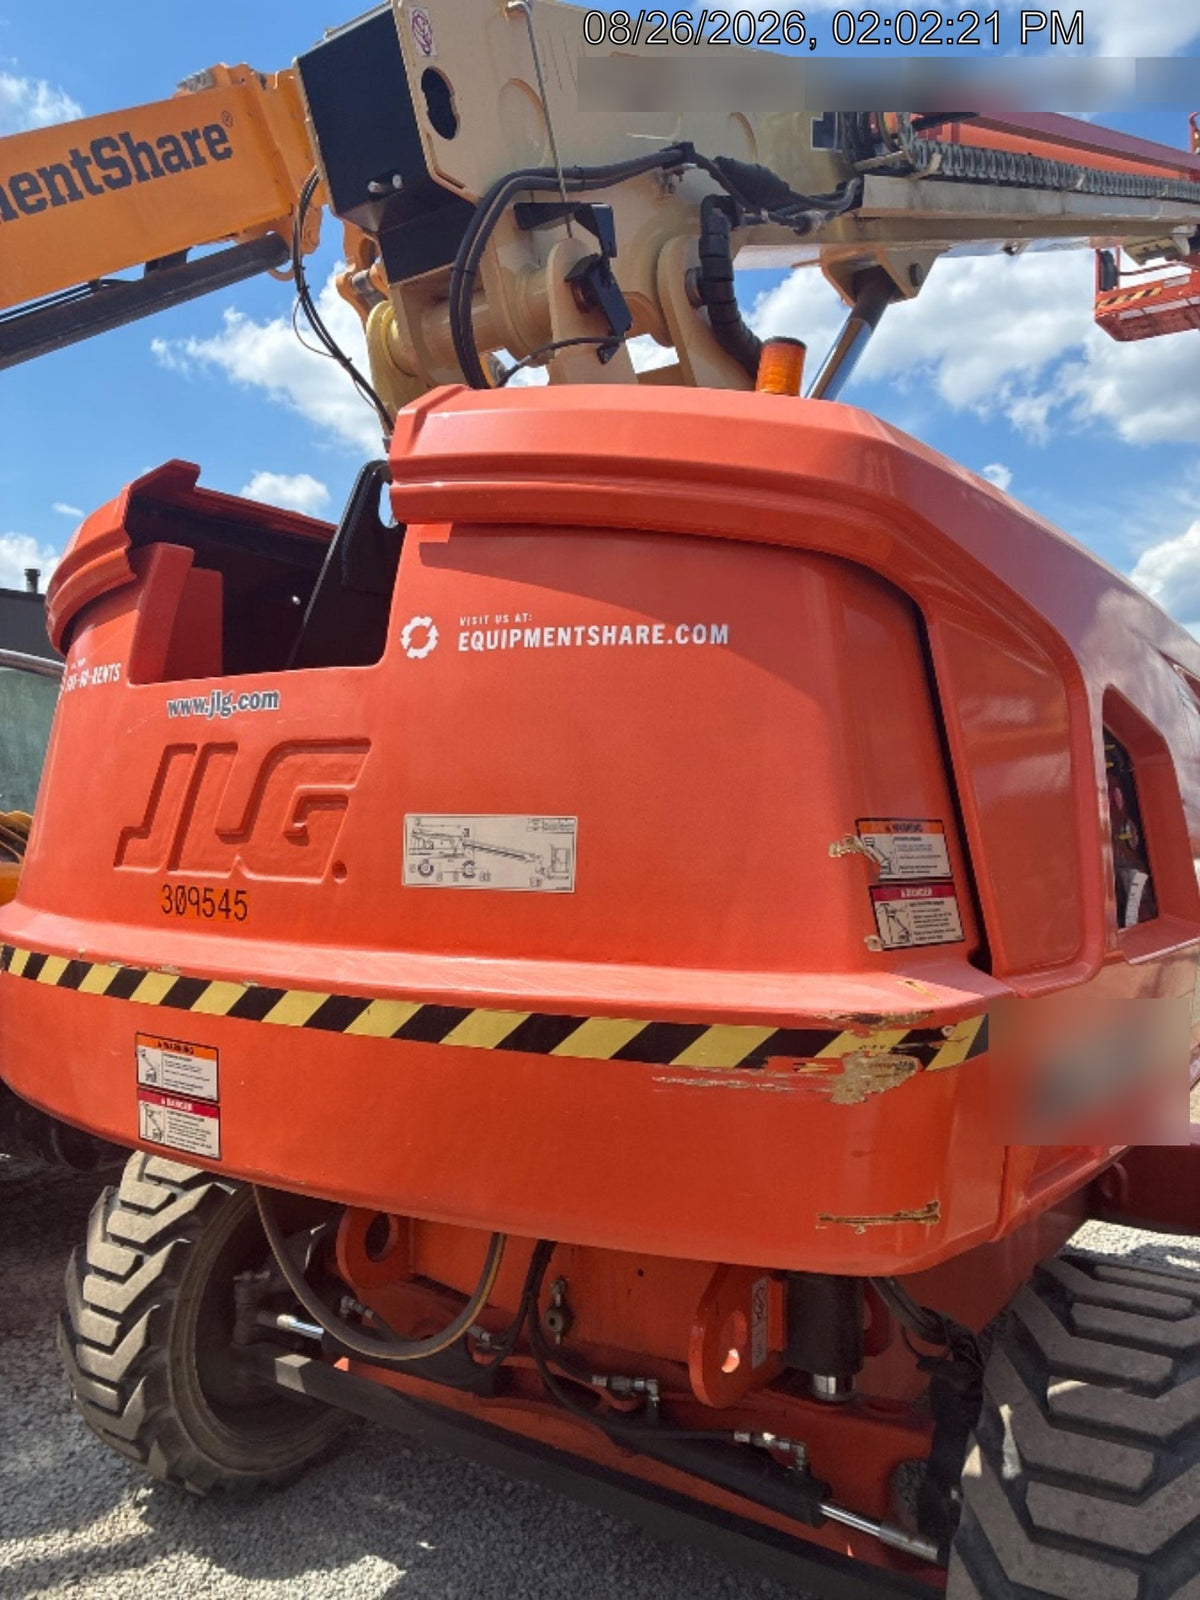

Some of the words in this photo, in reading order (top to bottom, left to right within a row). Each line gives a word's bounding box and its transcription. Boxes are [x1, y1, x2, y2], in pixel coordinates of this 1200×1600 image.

[459, 615, 490, 627] VISIT
[495, 614, 510, 625] US
[514, 611, 533, 623] AT:
[457, 623, 730, 652] EQUIPMENTSHARE.COM
[167, 689, 280, 720] www.jlg.com
[161, 883, 249, 922] 309545
